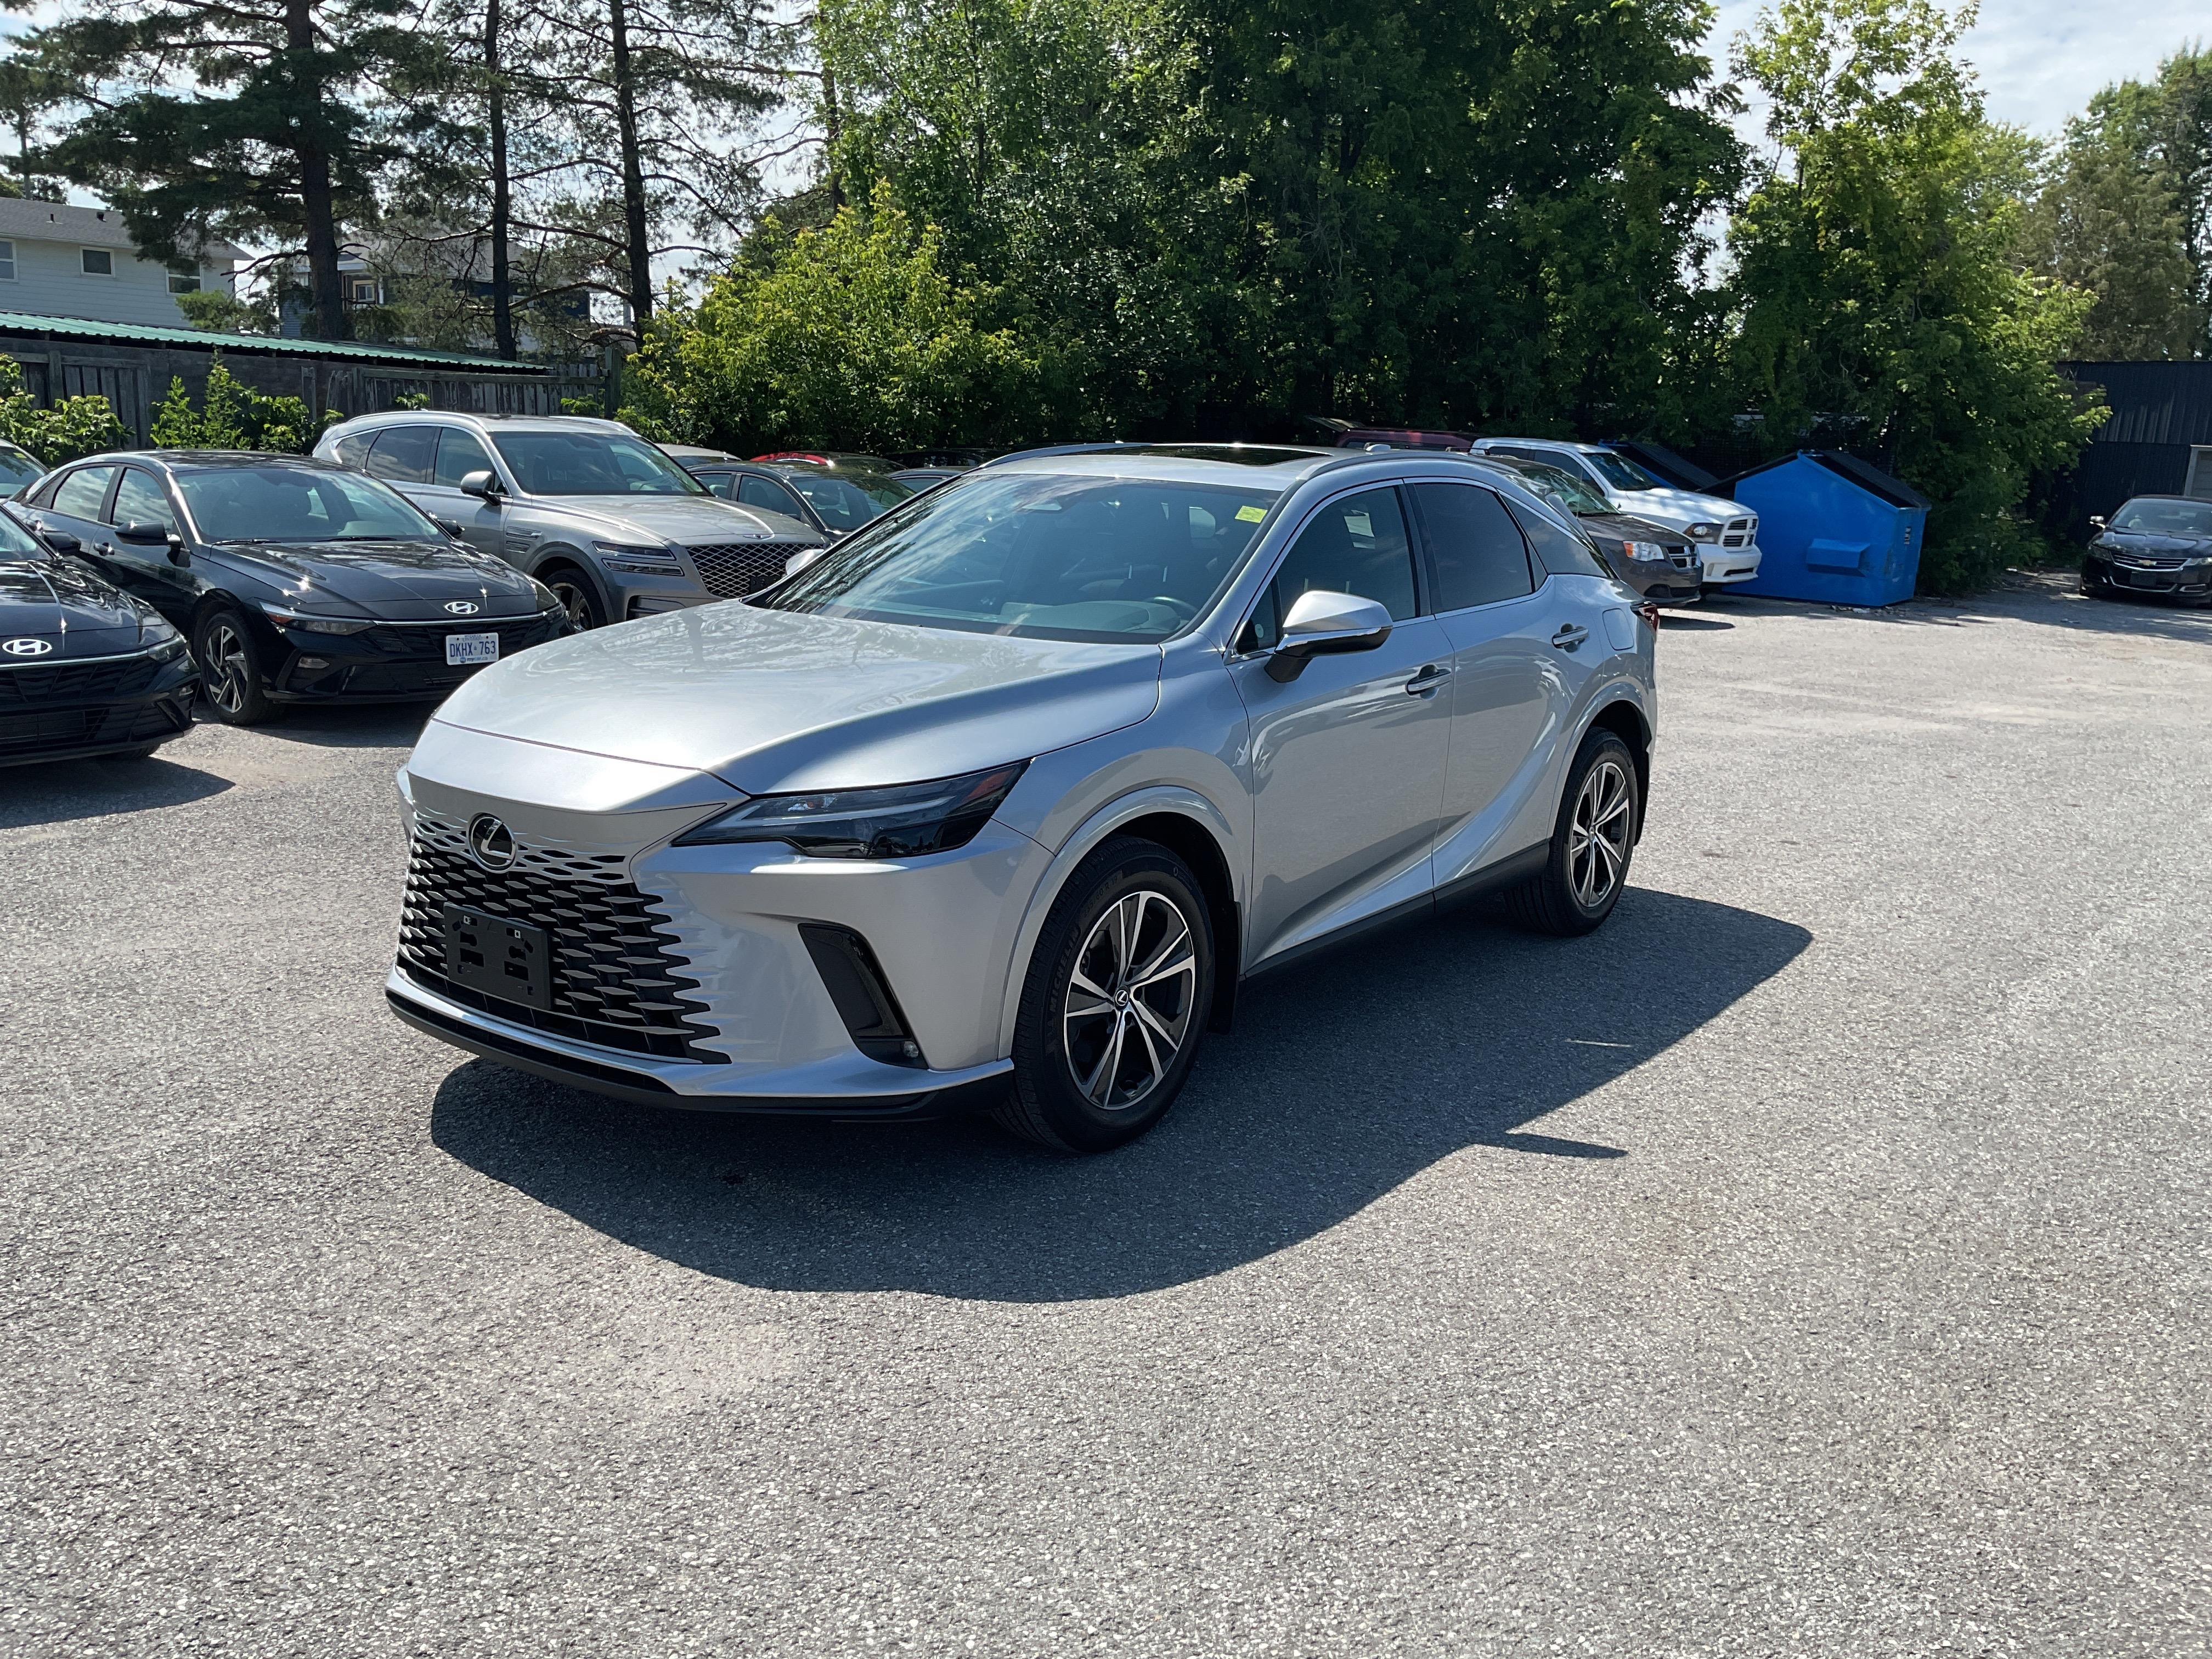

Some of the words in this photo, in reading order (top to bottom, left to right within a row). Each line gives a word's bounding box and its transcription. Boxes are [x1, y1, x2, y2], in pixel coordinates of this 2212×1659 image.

[450, 642, 473, 657] DKHX
[479, 640, 496, 655] 763
[1049, 926, 1079, 1013] MICHELIN
